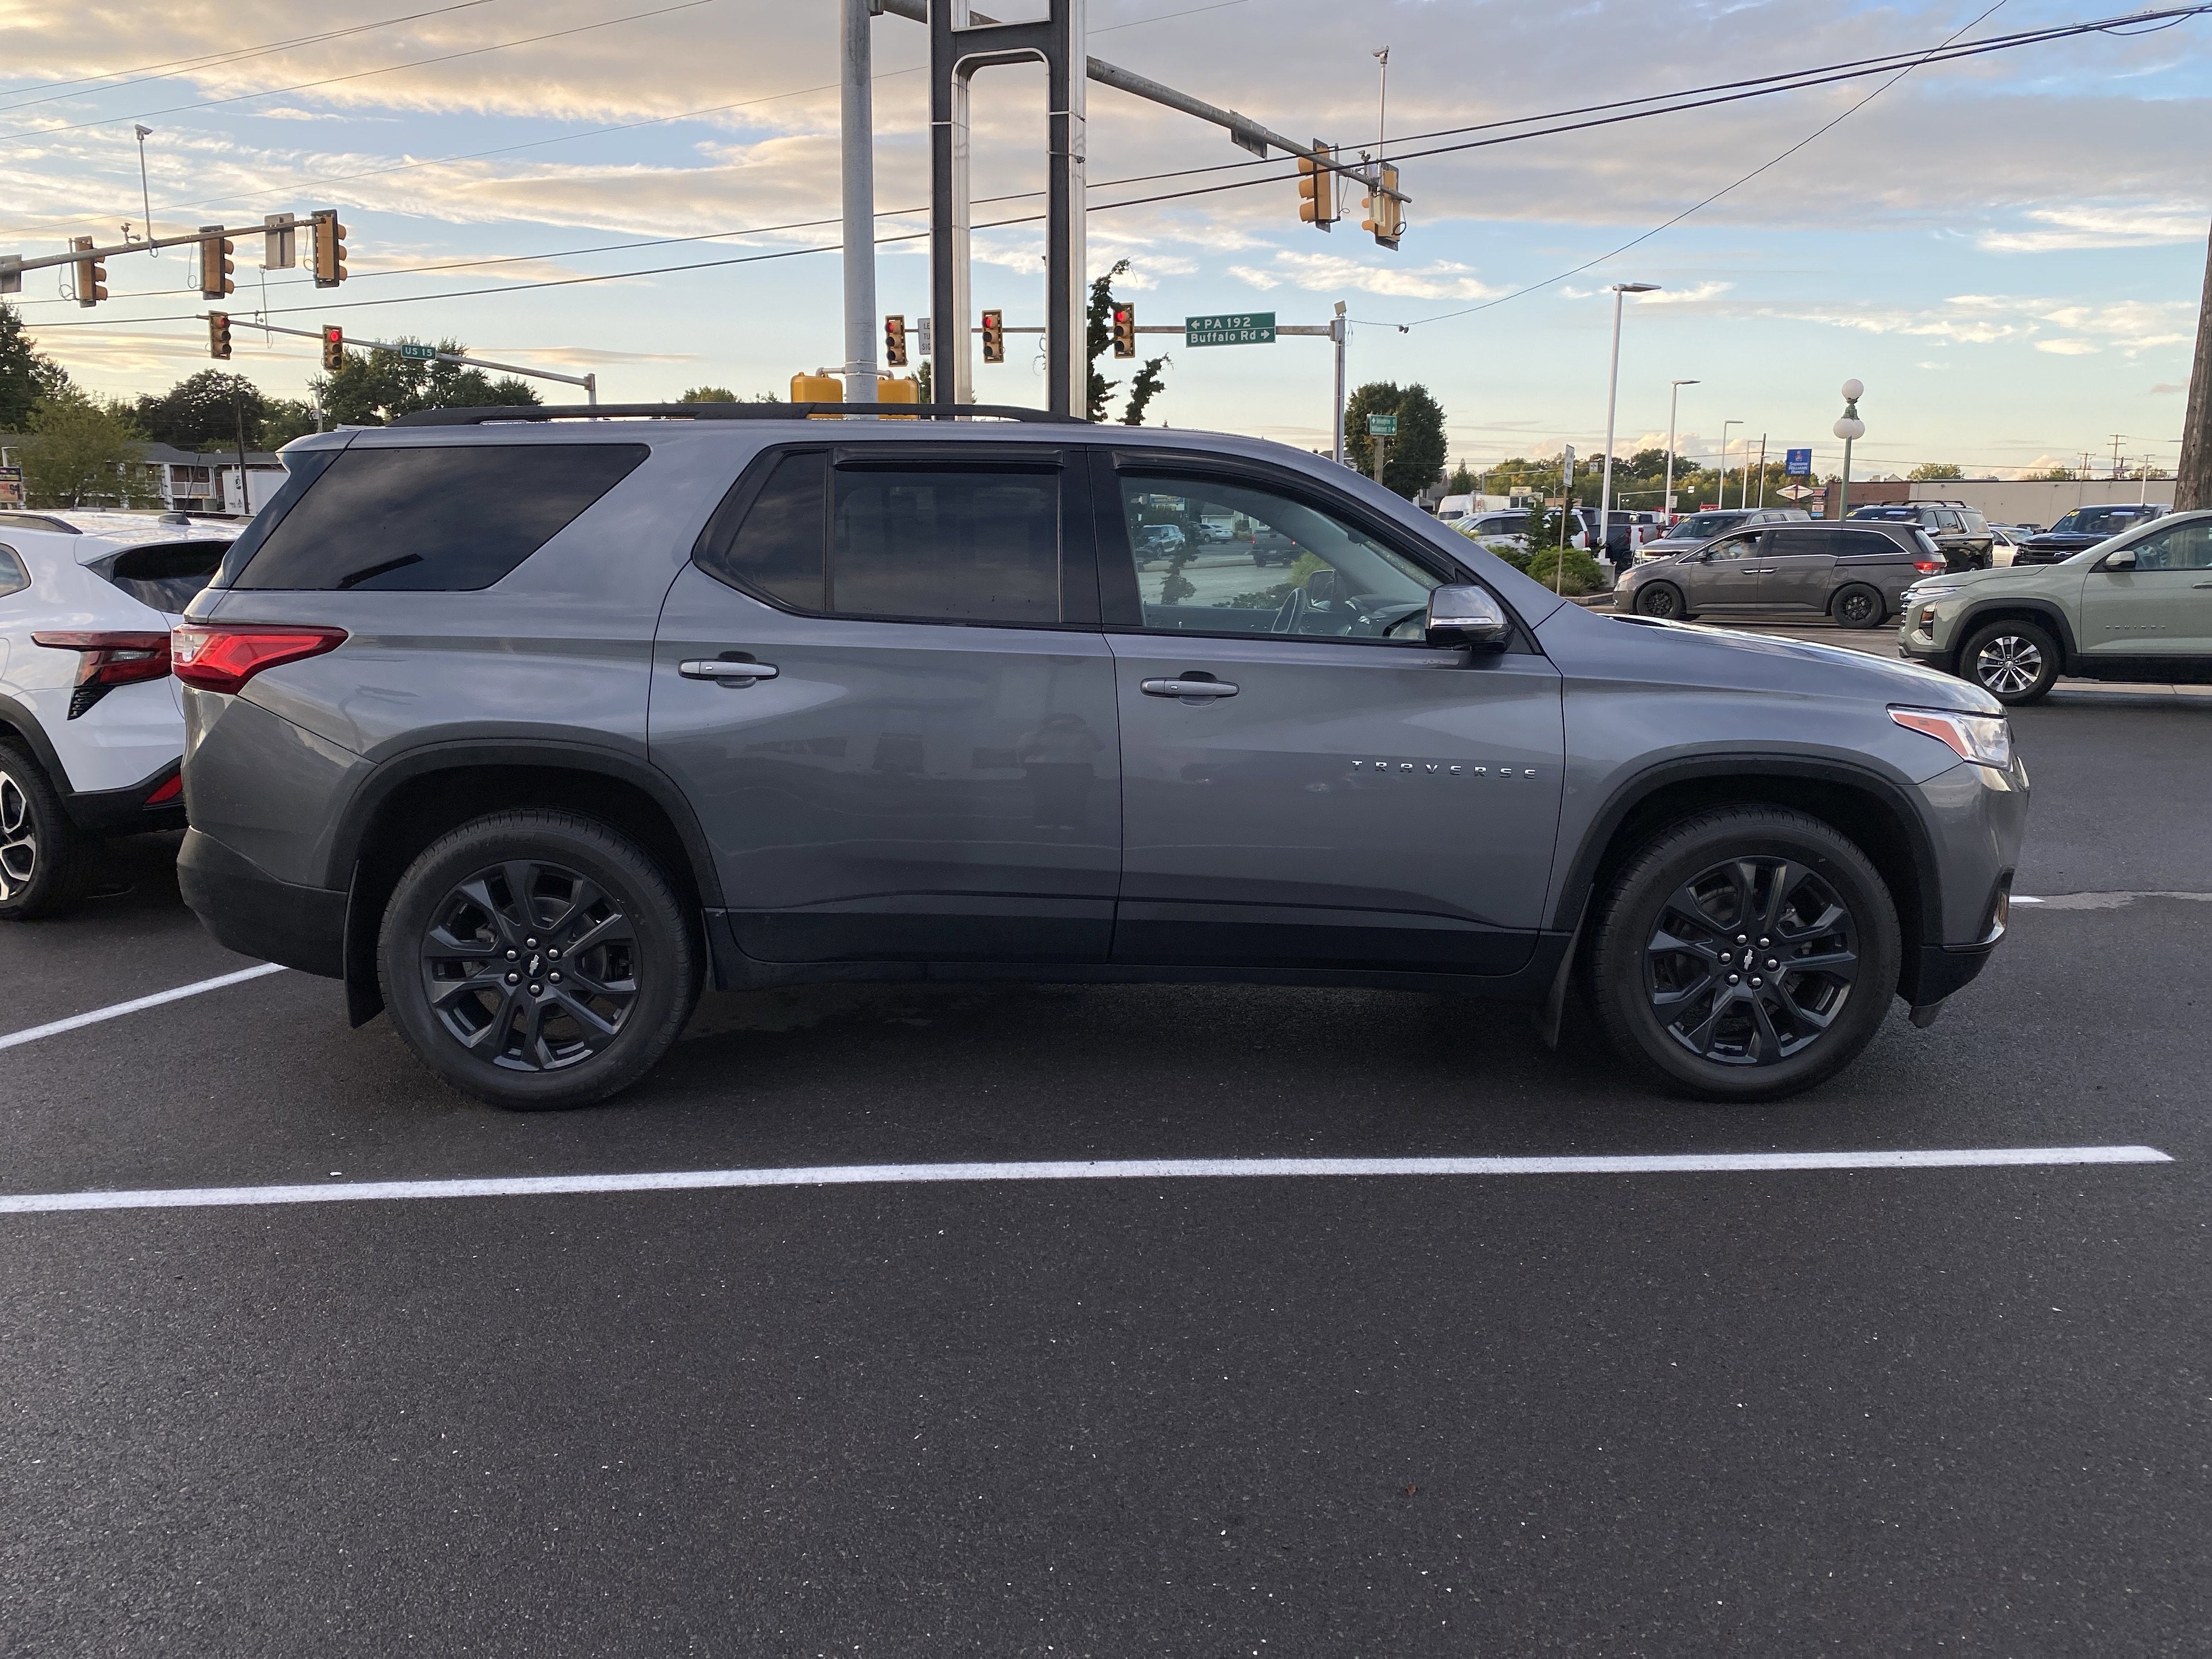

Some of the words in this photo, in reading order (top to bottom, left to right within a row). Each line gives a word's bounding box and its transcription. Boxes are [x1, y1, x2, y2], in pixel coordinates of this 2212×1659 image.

[1204, 319, 1222, 329] PA
[1227, 317, 1251, 328] 192
[1190, 330, 1235, 343] Buffalo
[1240, 330, 1256, 341] Rd
[405, 347, 417, 356] US
[421, 348, 433, 357] 15
[1351, 760, 1536, 779] TRAVERSE
